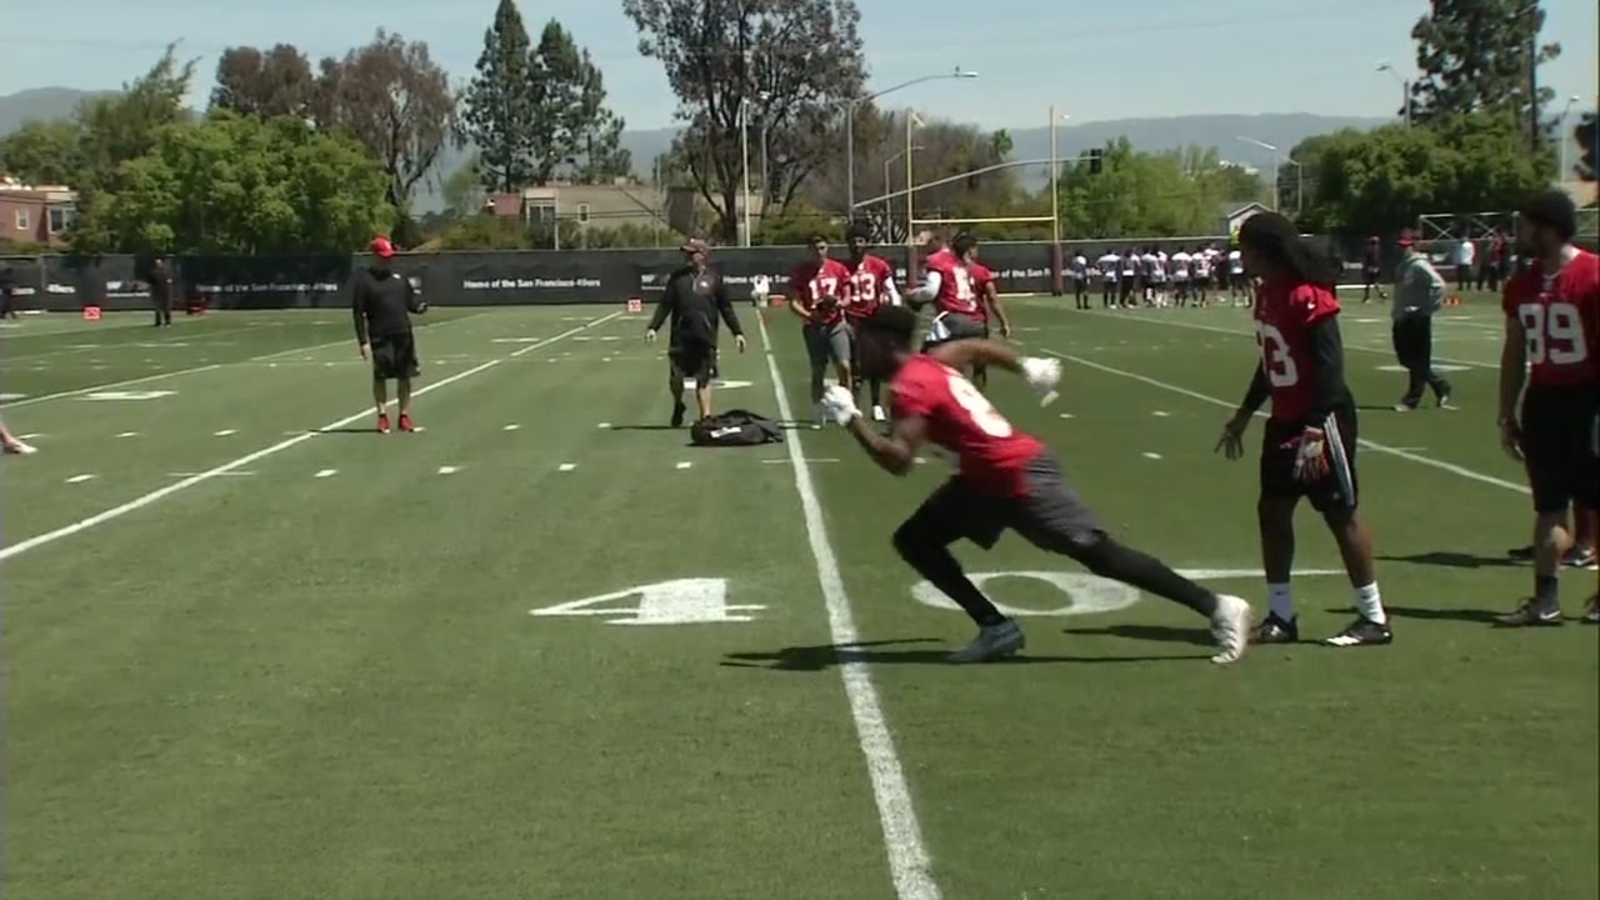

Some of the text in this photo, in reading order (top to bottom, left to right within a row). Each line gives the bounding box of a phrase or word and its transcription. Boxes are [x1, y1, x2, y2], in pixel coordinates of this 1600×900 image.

[463, 280, 490, 289] Home
[501, 279, 516, 288] the
[517, 279, 533, 288] San
[808, 277, 838, 307] 17
[850, 273, 876, 302] 13
[1519, 303, 1587, 364] 89
